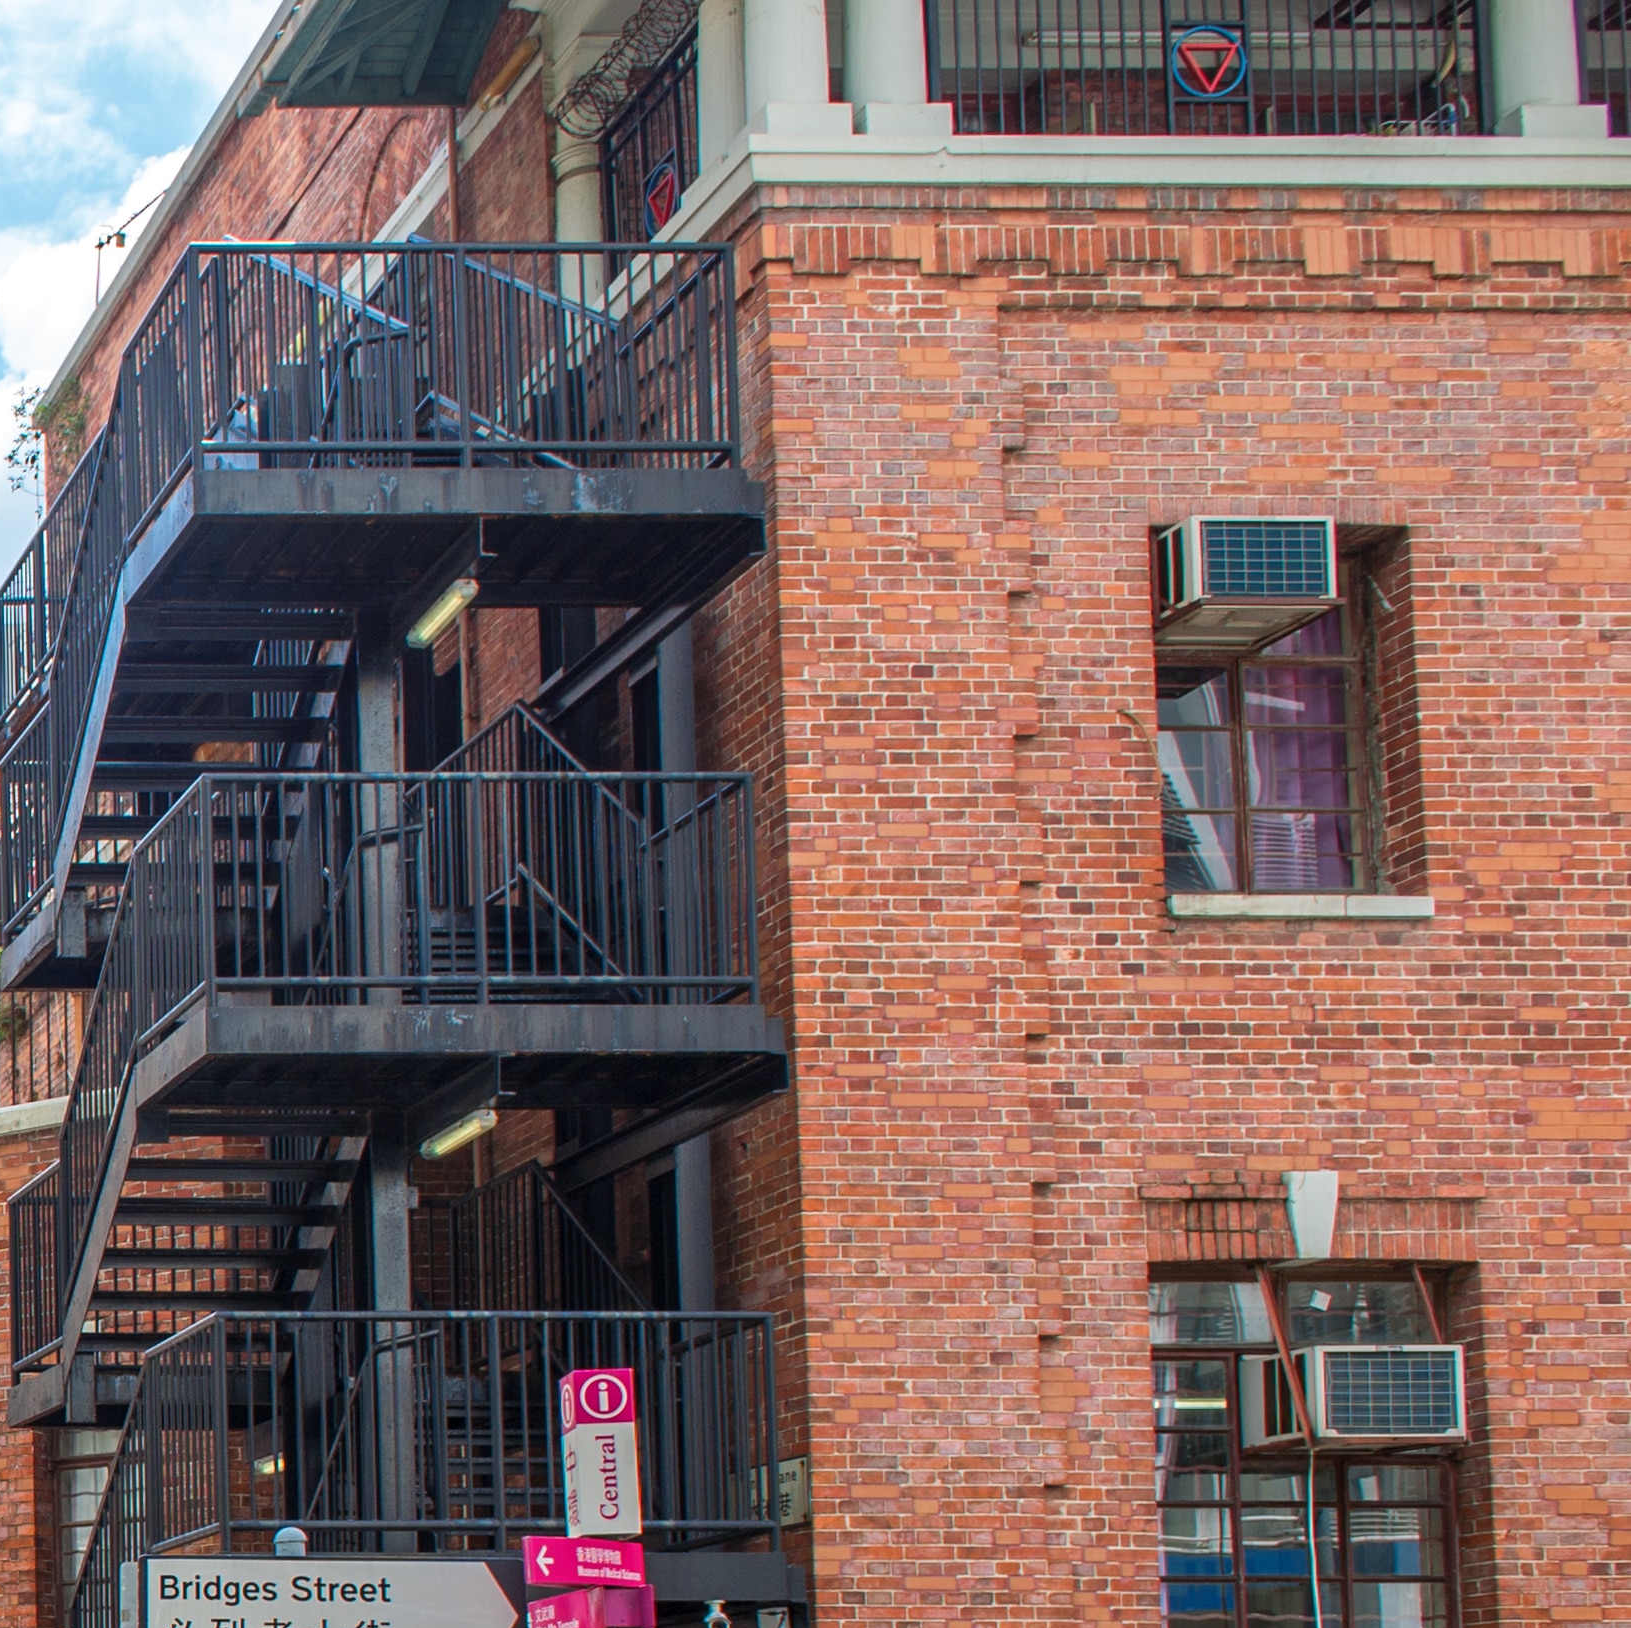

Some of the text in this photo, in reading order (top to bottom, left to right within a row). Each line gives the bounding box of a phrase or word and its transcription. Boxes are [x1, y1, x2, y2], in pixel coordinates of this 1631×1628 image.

[595, 1434, 619, 1520] Central
[577, 1565, 600, 1577] Museum
[605, 1567, 622, 1579] Medical
[622, 1569, 641, 1581] Sciences
[159, 1575, 392, 1606] Bridges Street
[535, 1605, 555, 1623] 文武廟
